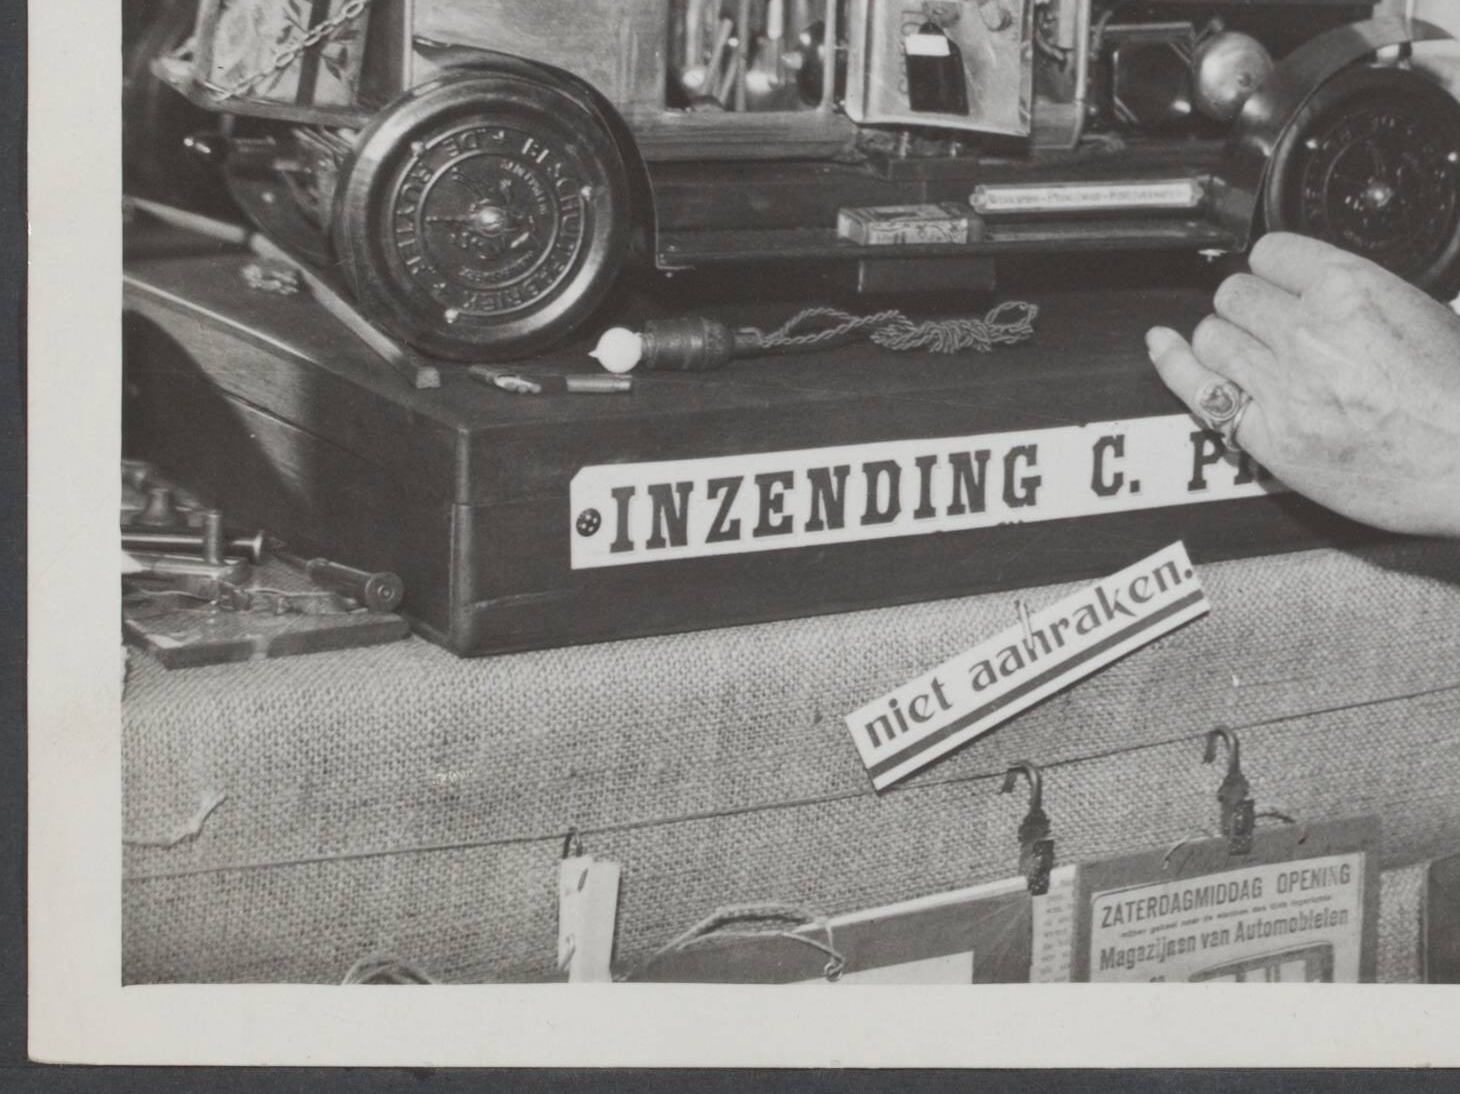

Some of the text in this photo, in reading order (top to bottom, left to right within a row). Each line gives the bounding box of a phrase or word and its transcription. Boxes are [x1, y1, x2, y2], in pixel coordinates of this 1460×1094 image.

[608, 441, 1043, 553] INZENDING
[1090, 433, 1141, 499] C.
[864, 559, 1196, 750] niet aanraken.
[1099, 906, 1349, 971] Magazijnen van Automobielen
[1101, 863, 1352, 929] ZATERDAGMIDDAG OPENING
